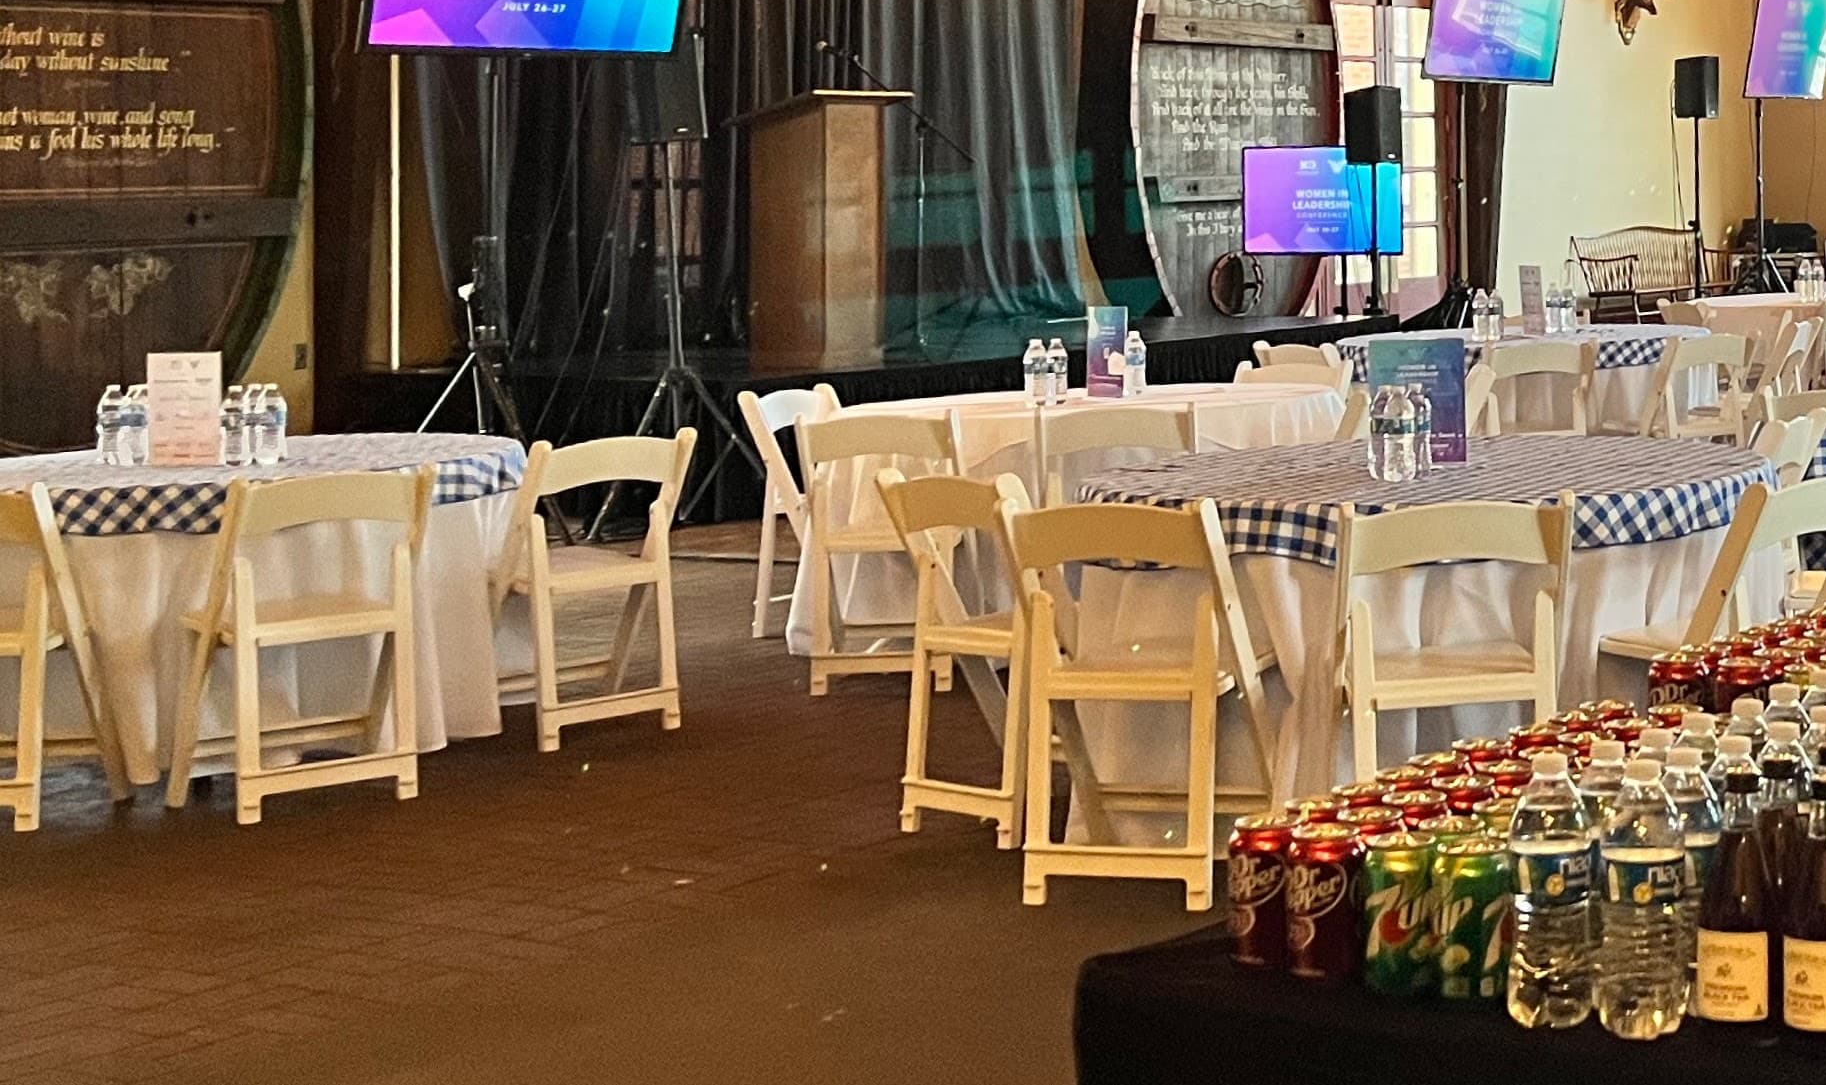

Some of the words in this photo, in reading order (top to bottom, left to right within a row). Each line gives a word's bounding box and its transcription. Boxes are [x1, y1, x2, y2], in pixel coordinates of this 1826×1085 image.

[502, 2, 530, 12] JULY
[534, 3, 567, 14] 26-27
[91, 27, 106, 47] is
[36, 50, 96, 71] without
[39, 126, 76, 160] fool
[110, 126, 152, 149] whole
[1296, 189, 1336, 198] WOMEN
[1338, 189, 1350, 198] IN
